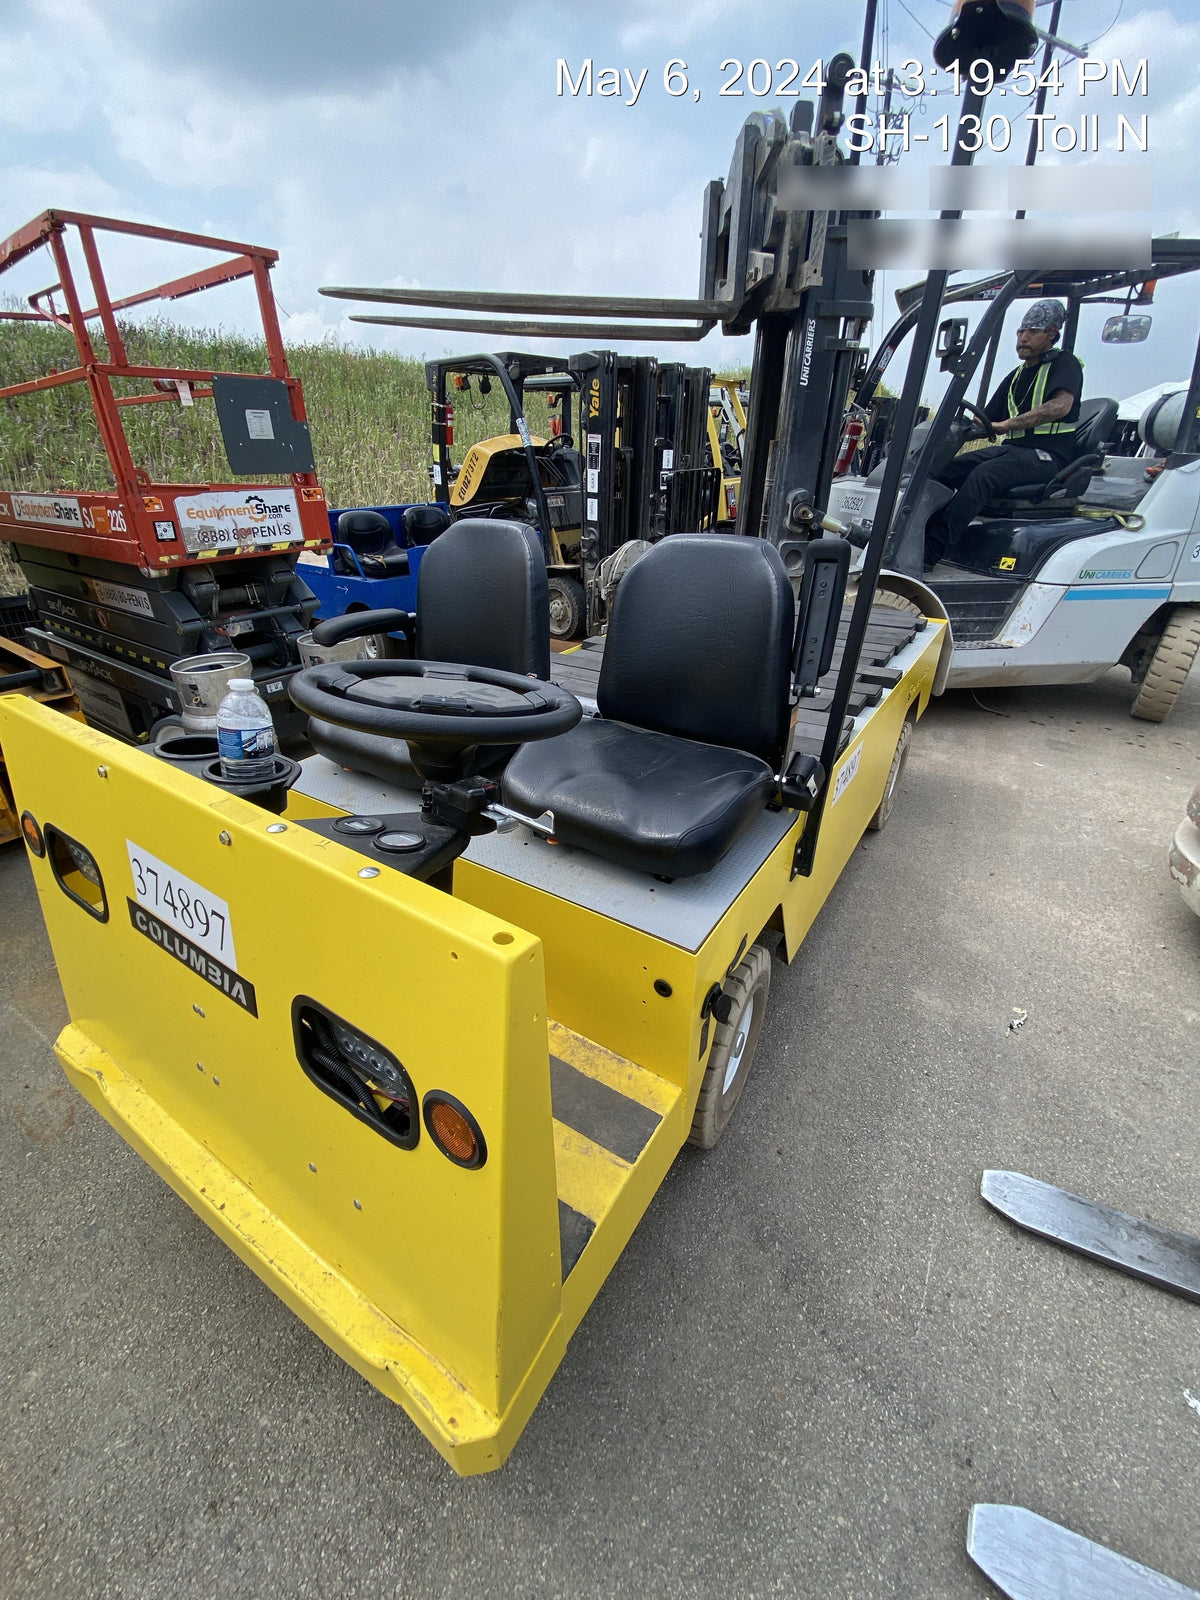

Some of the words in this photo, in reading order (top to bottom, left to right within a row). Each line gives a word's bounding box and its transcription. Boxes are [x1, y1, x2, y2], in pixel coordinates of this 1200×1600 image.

[800, 318, 816, 386] UNICARRIERS
[589, 378, 600, 418] Yale
[458, 452, 479, 501] E0027372
[186, 503, 292, 521] EquipmentShare
[131, 857, 227, 952] 374897
[135, 910, 248, 1006] COLUMBIA
